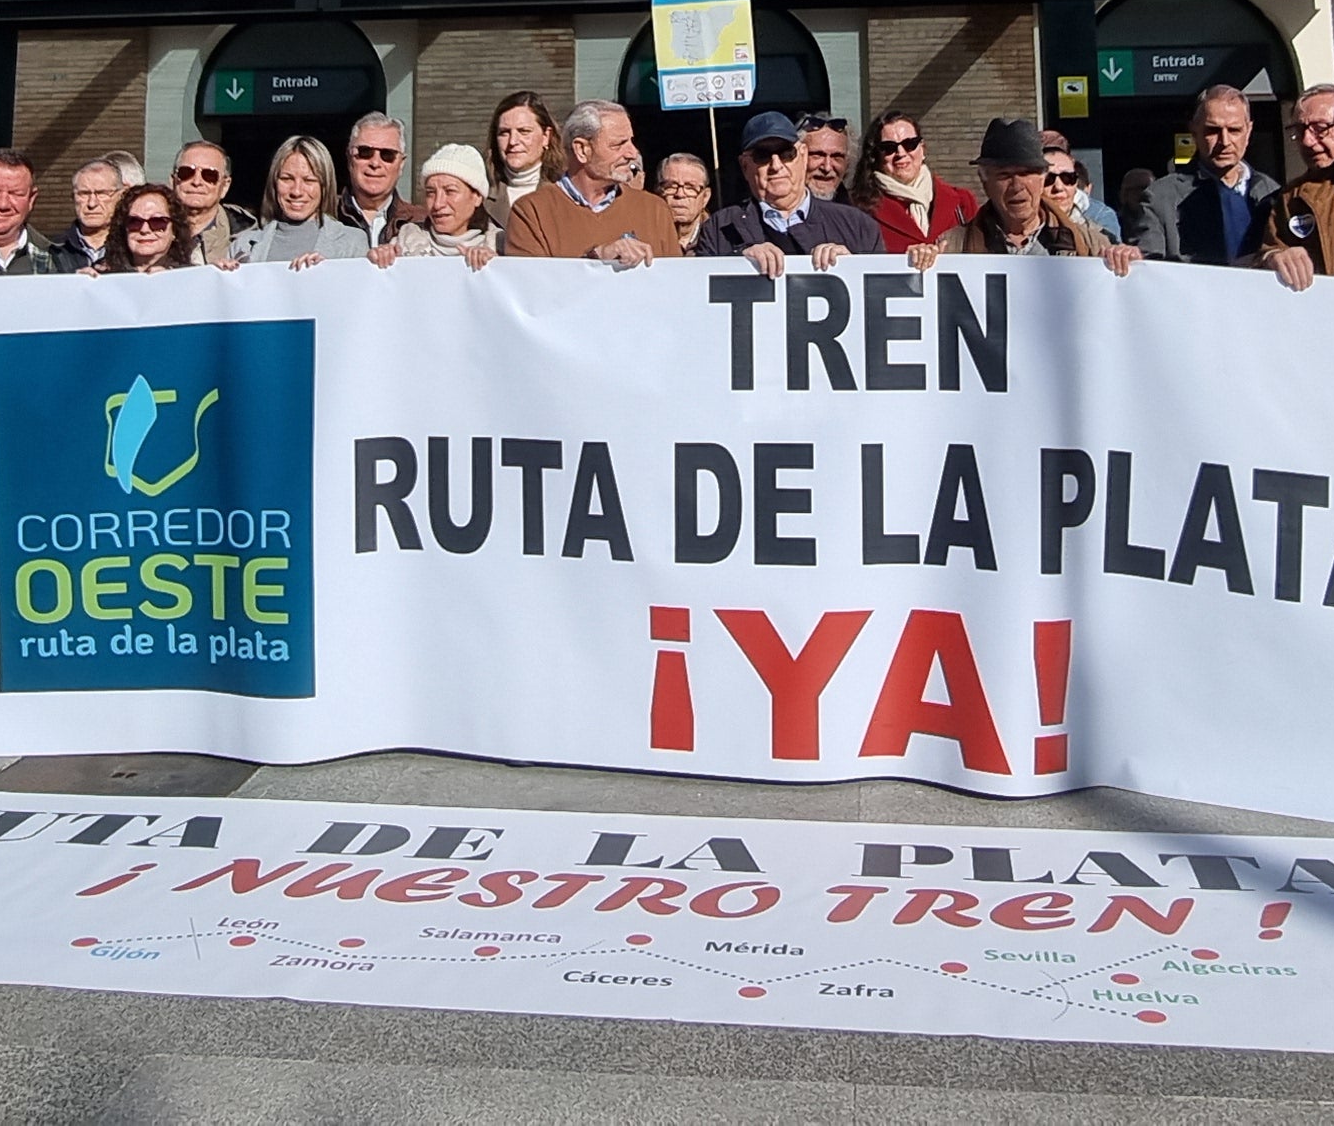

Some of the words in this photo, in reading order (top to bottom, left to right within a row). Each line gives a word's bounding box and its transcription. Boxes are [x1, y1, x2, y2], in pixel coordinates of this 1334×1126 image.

[1152, 55, 1204, 68] Entrada
[272, 76, 318, 88] Entrada
[1153, 74, 1178, 82] ENTRY
[709, 273, 1008, 392] TREN
[354, 436, 634, 562] RUTA
[674, 442, 816, 566] DE
[861, 443, 998, 571] LA
[17, 508, 291, 552] CORREDOR
[15, 553, 289, 624] OESTE
[20, 629, 97, 657] ruta
[110, 624, 154, 657] de
[167, 623, 198, 655] la
[209, 627, 290, 664] plata
[649, 606, 1072, 775] ¡YA!
[295, 821, 505, 860] DE
[575, 830, 767, 873] LA
[217, 916, 280, 931] León
[418, 926, 562, 945] Salamanca
[90, 945, 161, 961] Gijón
[705, 940, 805, 957] Mérida
[983, 948, 1076, 965] Sevilla
[269, 954, 375, 972] Zamora
[1162, 959, 1298, 977] Algeciras
[563, 970, 673, 988] Cáceres
[818, 981, 895, 999] Zafra
[1092, 987, 1200, 1006] Huelva
